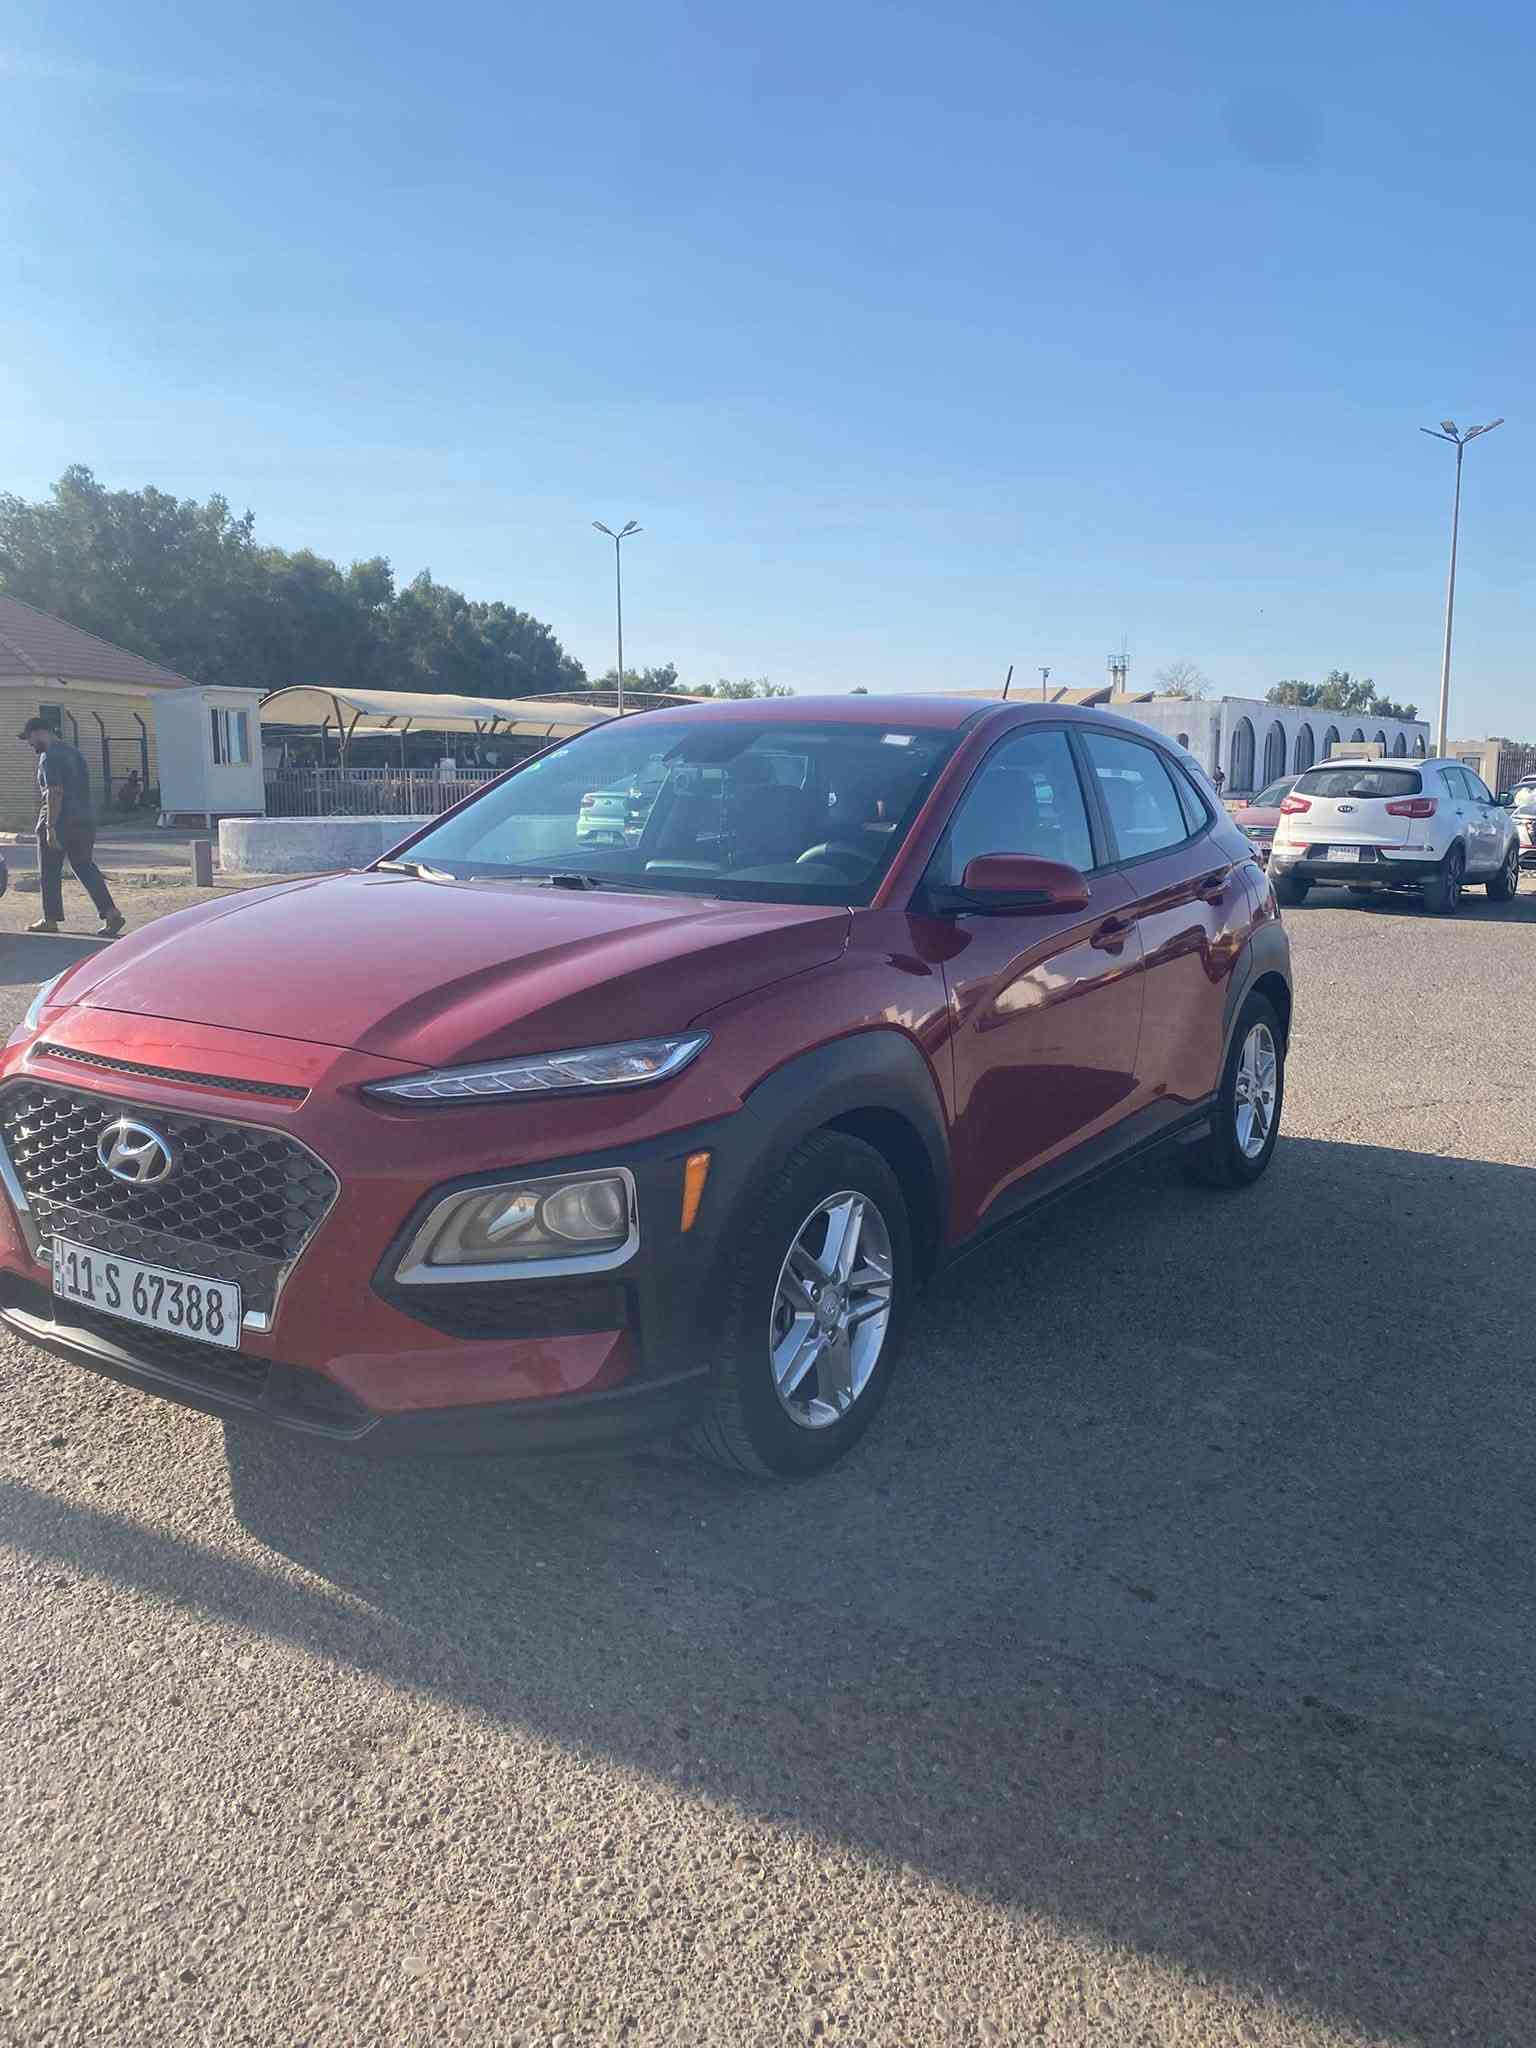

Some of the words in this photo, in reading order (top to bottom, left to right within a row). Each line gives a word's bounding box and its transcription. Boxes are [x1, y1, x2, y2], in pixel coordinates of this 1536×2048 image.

[67, 1251, 96, 1301] 11
[104, 1263, 121, 1309] S
[132, 1271, 224, 1337] 67388
